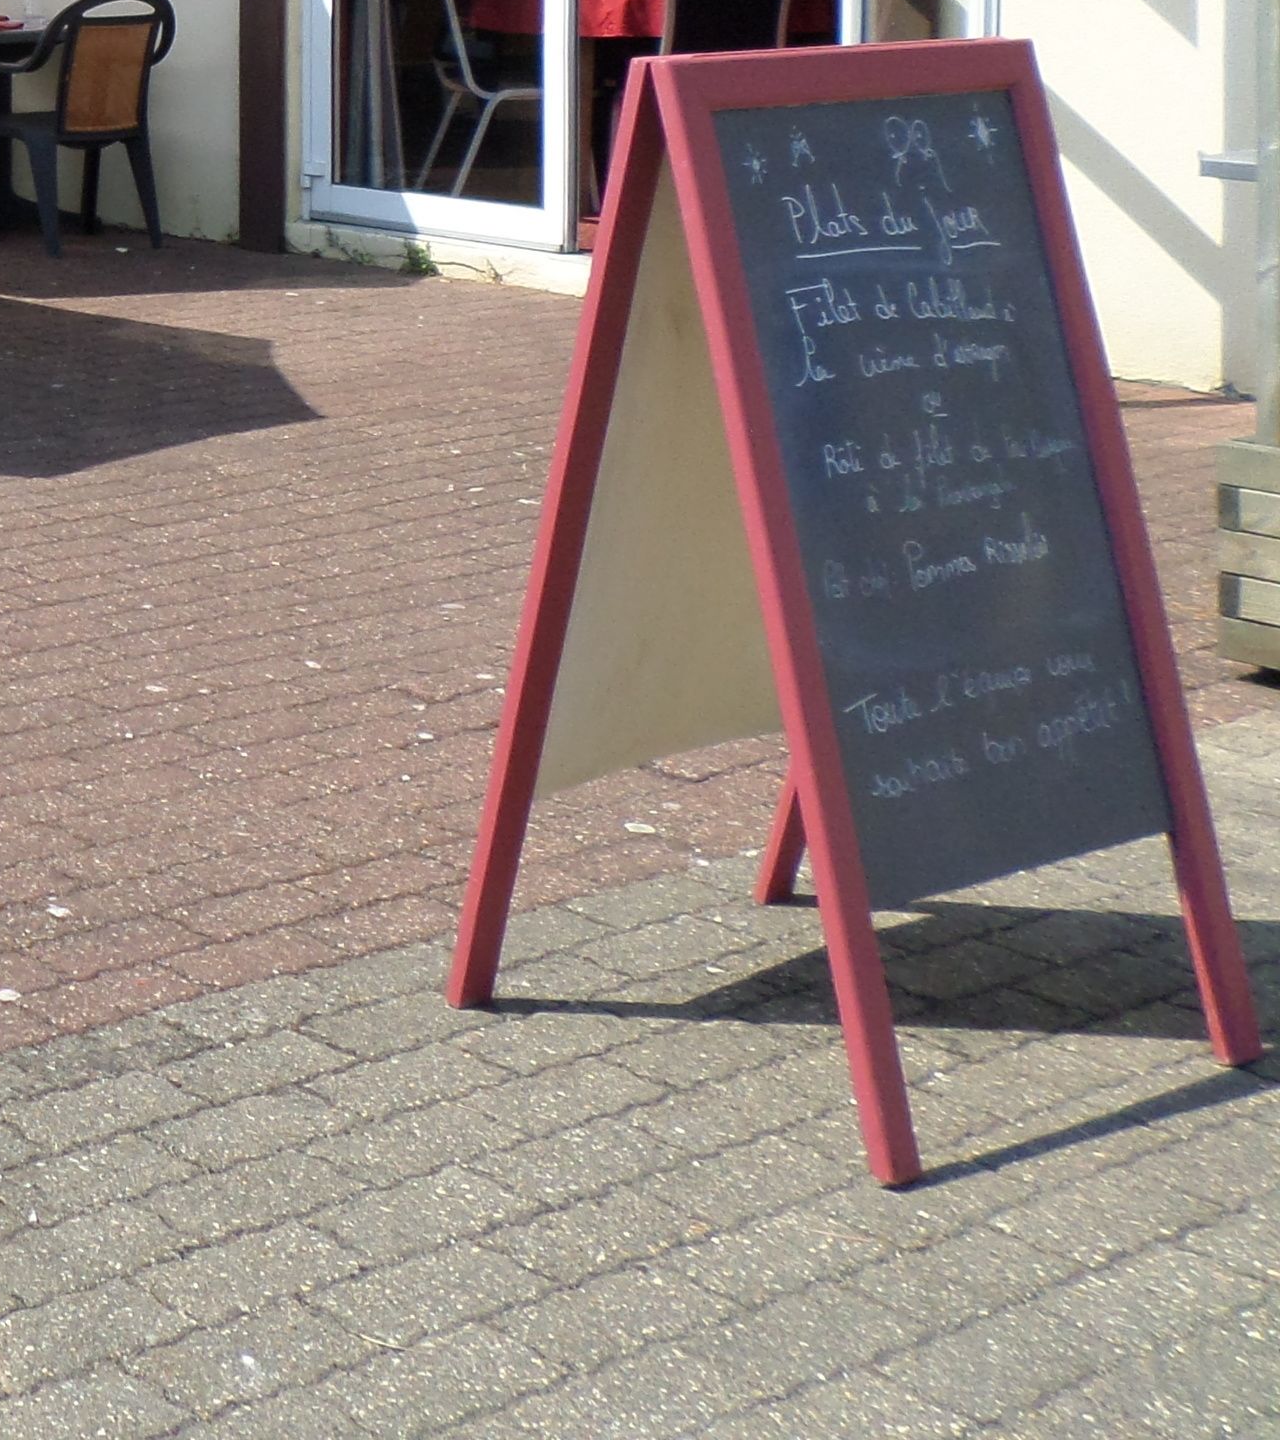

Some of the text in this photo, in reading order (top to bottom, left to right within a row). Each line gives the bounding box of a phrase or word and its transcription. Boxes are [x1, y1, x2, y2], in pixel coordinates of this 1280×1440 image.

[781, 183, 990, 266] Plats du jour
[784, 277, 861, 335] Filet
[874, 284, 900, 320] de
[795, 334, 836, 387] la
[859, 347, 920, 378] crème
[823, 440, 865, 479] Rôti
[842, 686, 922, 735] Toute
[982, 731, 1028, 765] bon
